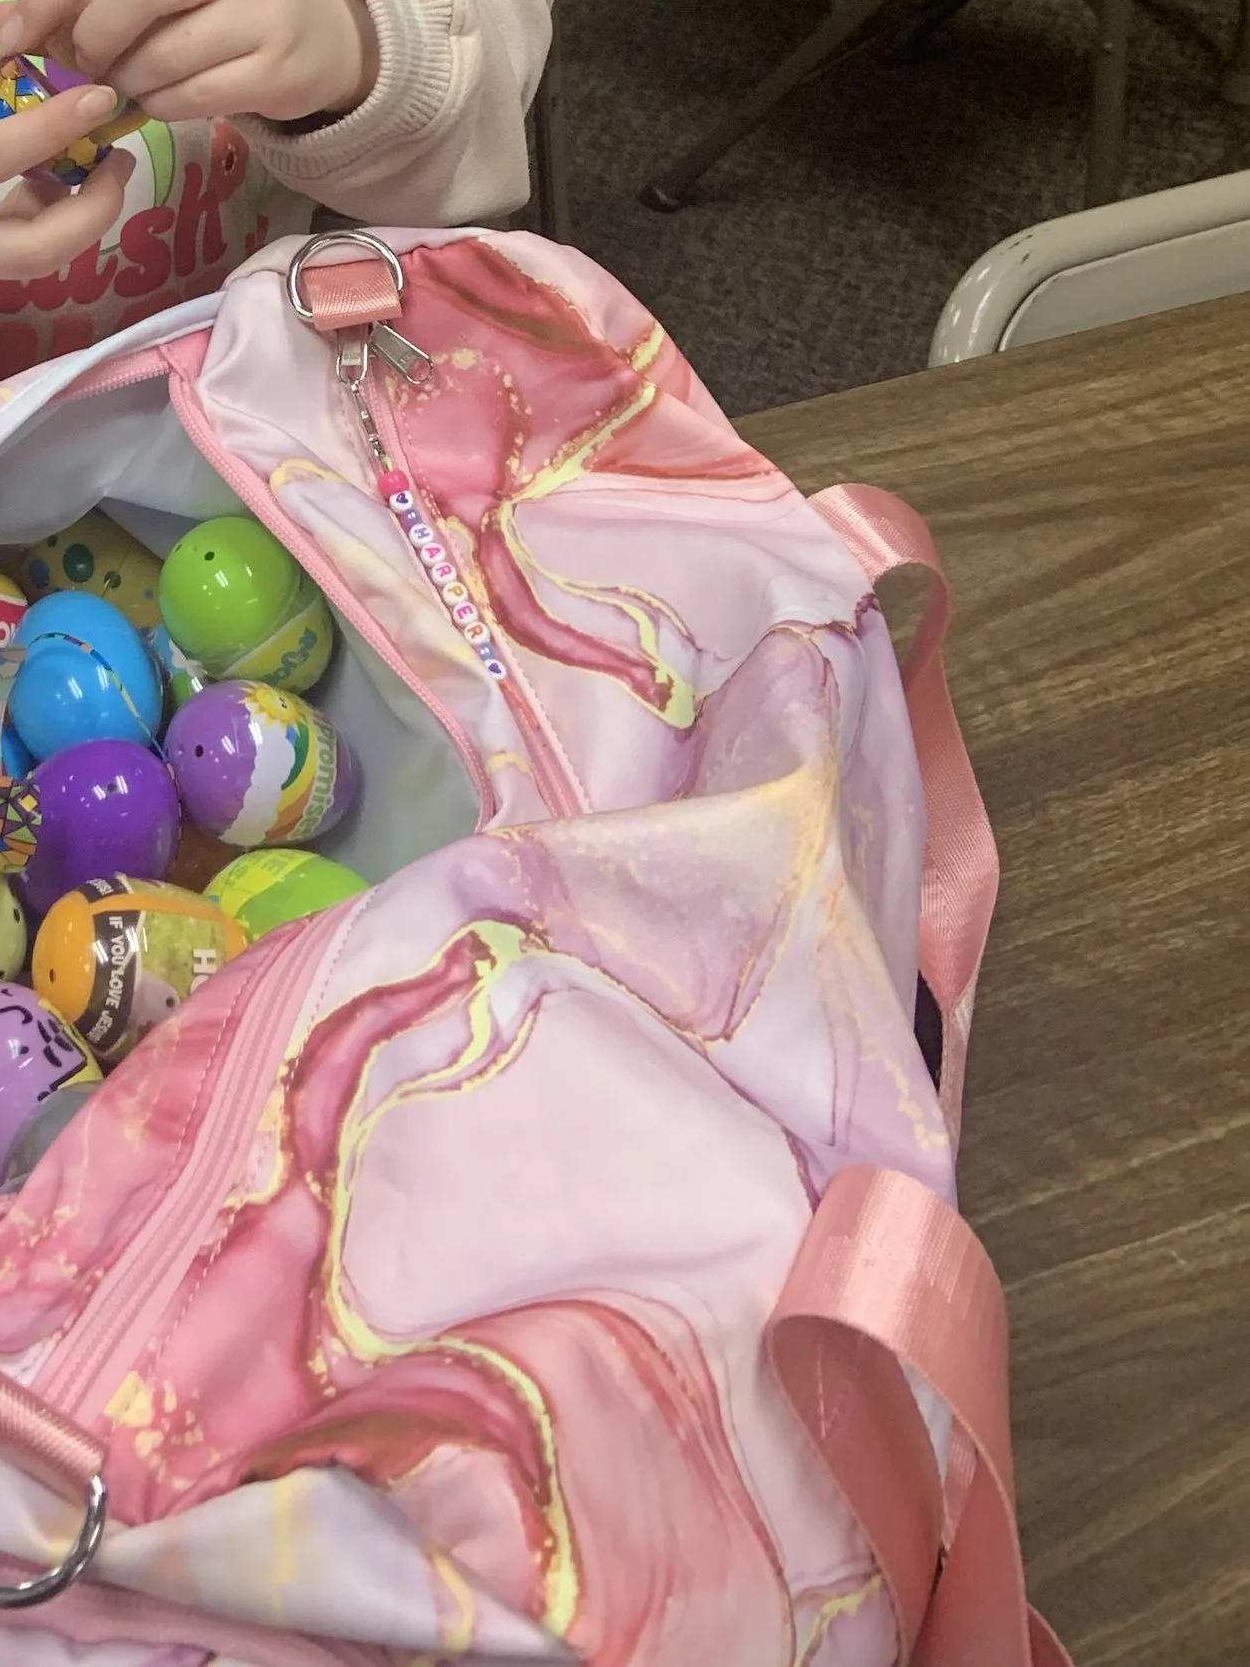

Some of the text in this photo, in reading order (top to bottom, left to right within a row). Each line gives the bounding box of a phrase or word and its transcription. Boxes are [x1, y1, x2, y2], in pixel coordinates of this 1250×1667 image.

[412, 524, 485, 640] HARPER
[108, 915, 124, 930] IF
[111, 934, 126, 966] YOU
[105, 967, 125, 1010] LOVE
